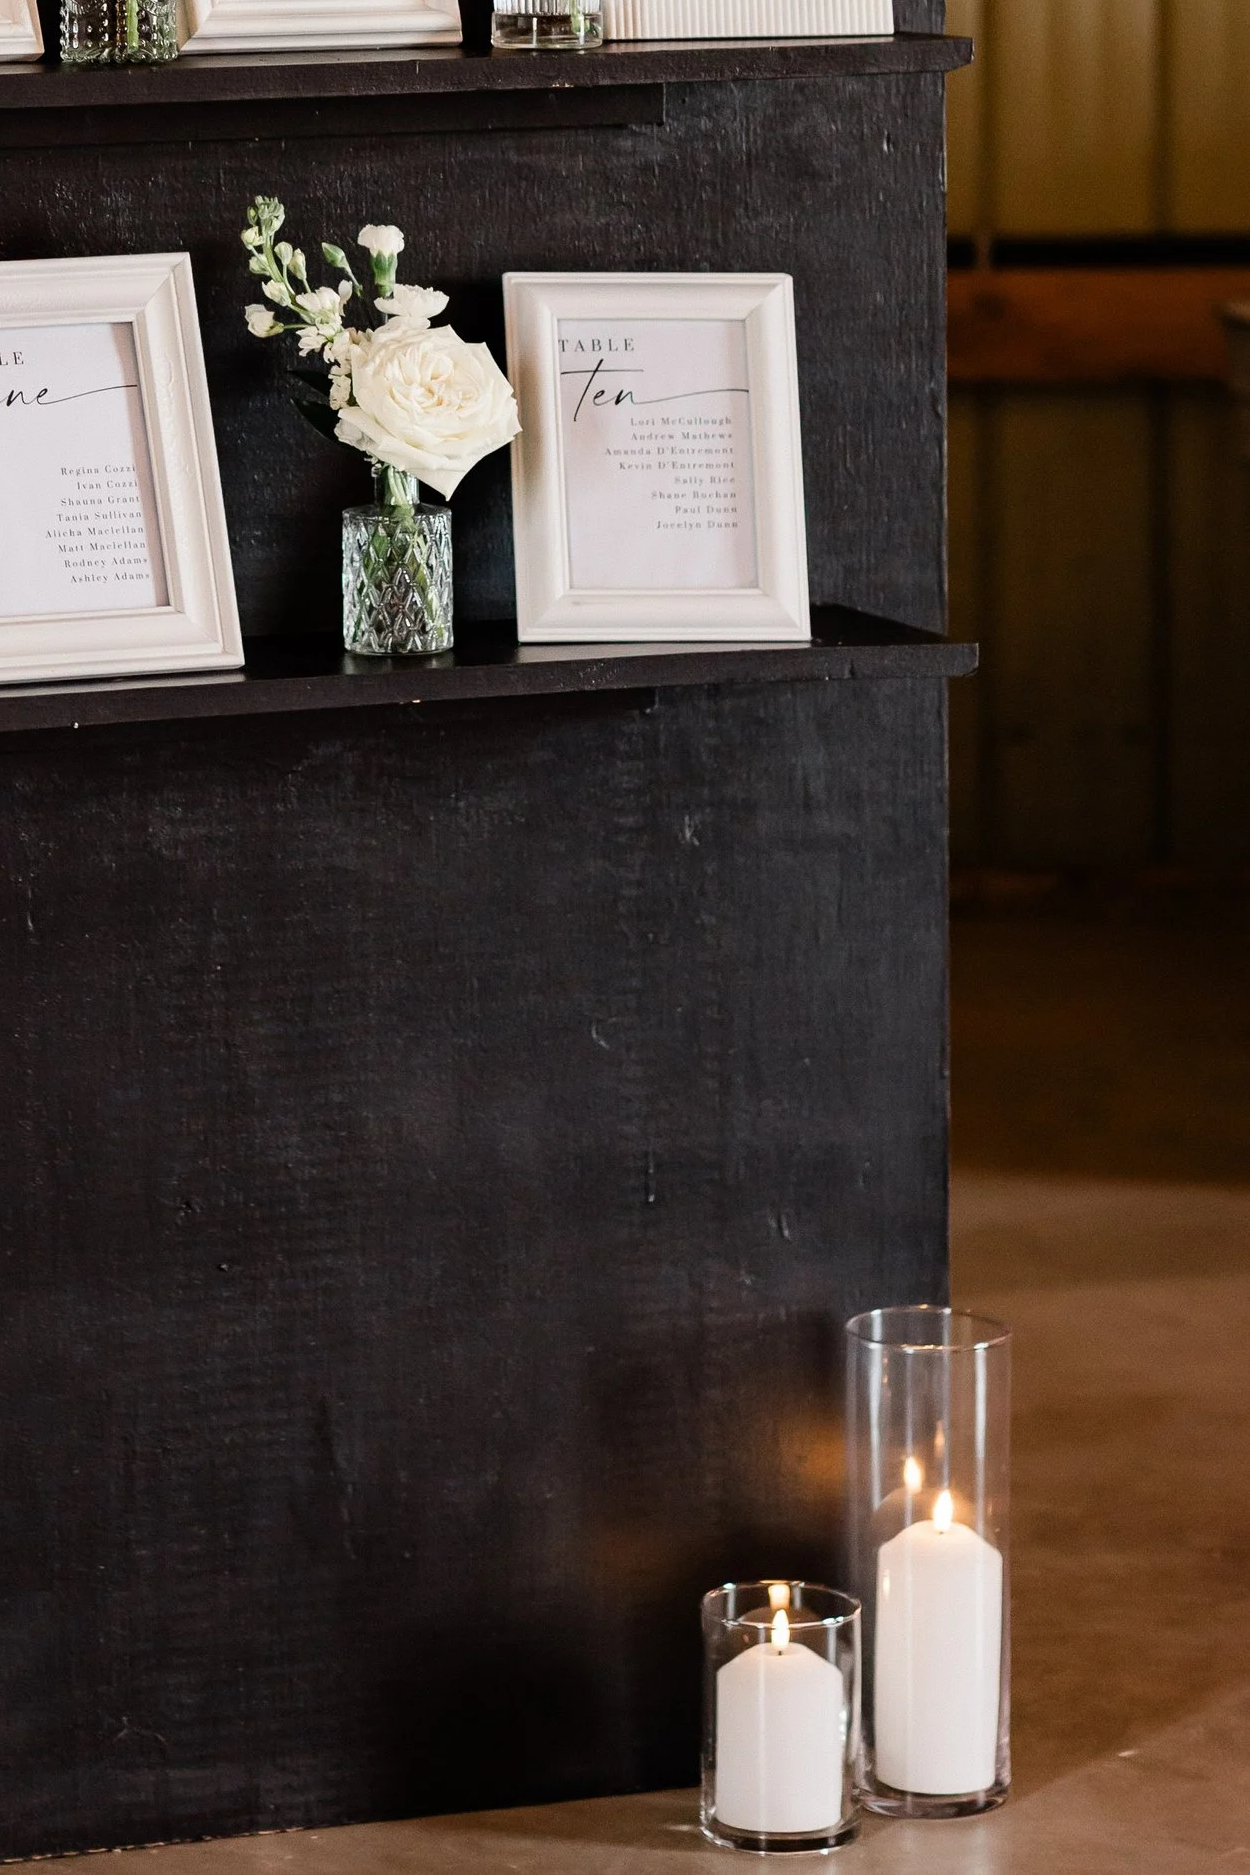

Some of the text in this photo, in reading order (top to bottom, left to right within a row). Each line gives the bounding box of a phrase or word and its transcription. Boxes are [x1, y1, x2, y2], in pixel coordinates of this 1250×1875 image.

[558, 338, 634, 352] TABLE
[61, 465, 136, 476] Regina Cozzi
[77, 480, 138, 490] Ivan Cozzi
[61, 496, 140, 506] Shauna Grant
[57, 511, 141, 522] Tania Sullivan
[58, 544, 84, 553] Matt
[64, 557, 148, 568] Rodney Adams
[71, 572, 150, 583] Ashley Adams
